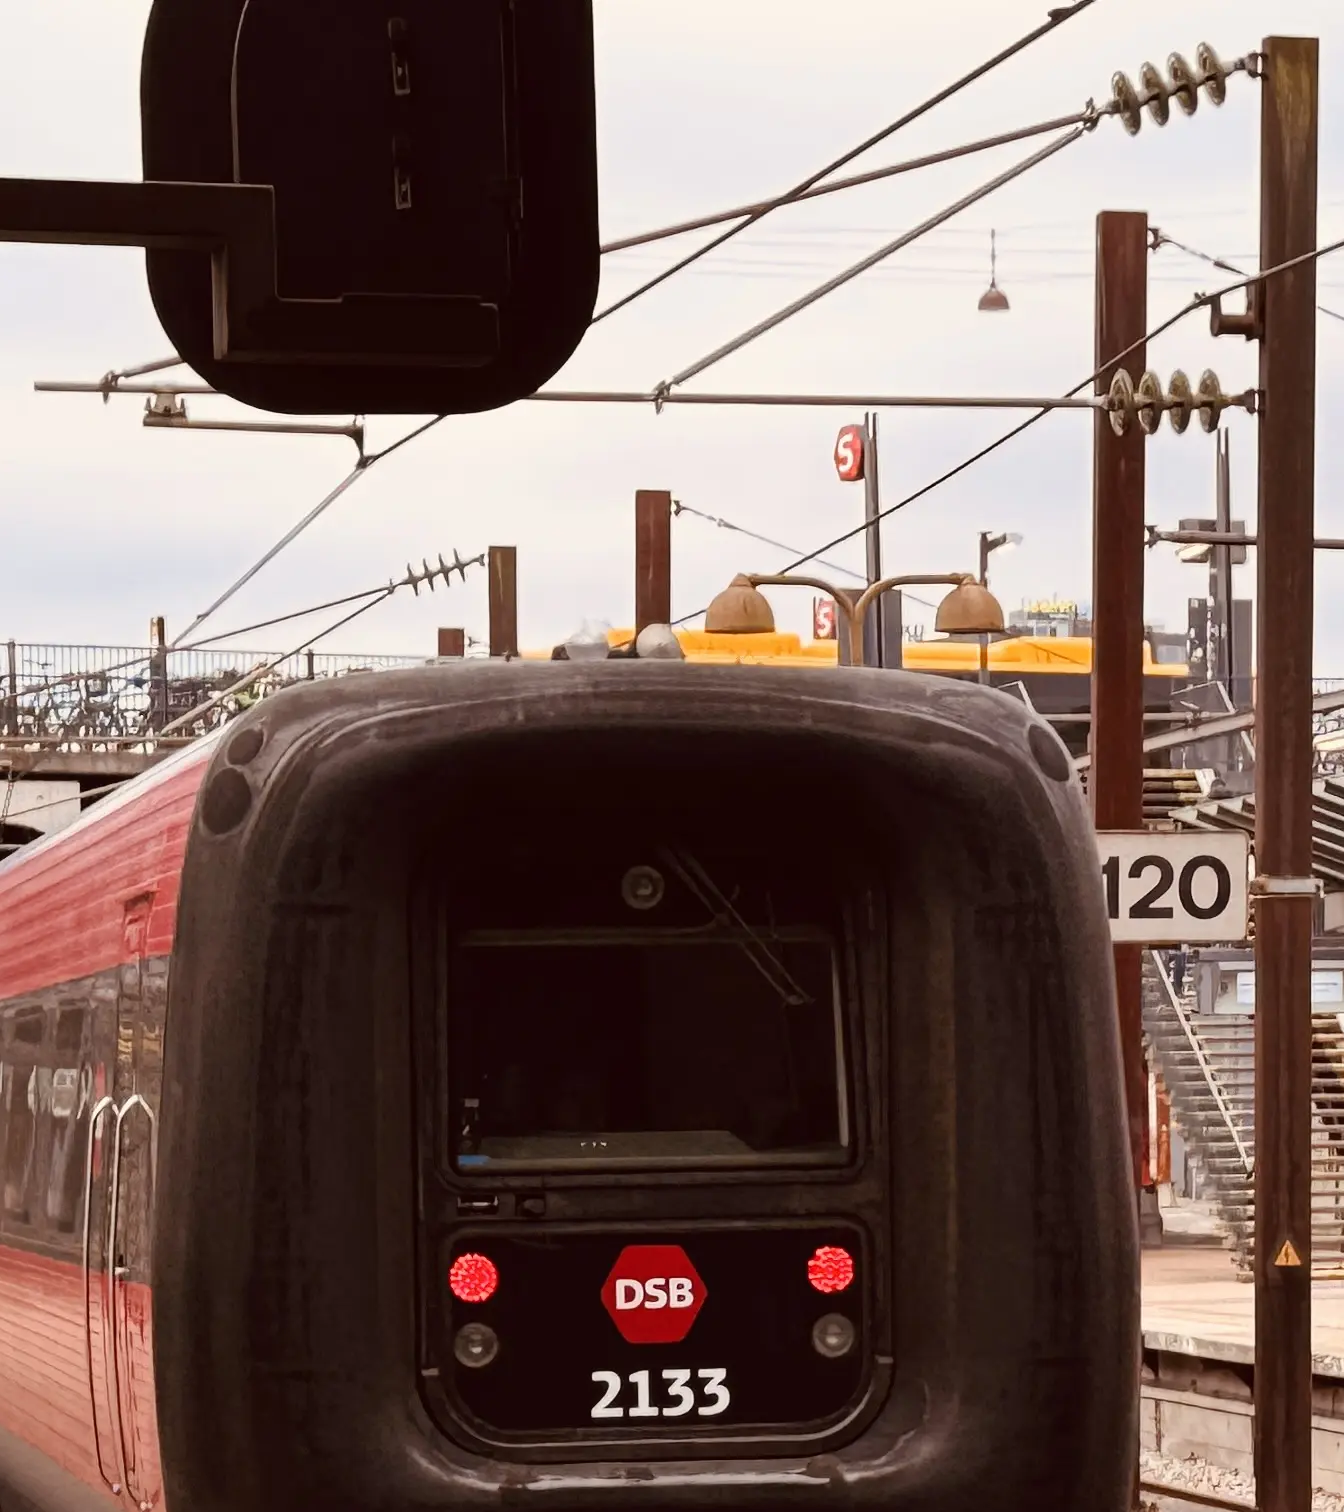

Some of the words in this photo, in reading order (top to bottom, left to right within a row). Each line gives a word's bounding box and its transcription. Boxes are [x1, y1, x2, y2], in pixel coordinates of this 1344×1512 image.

[837, 433, 854, 472] S
[1102, 855, 1231, 919] 120
[615, 1277, 694, 1310] DSB
[590, 1367, 731, 1418] 2133
